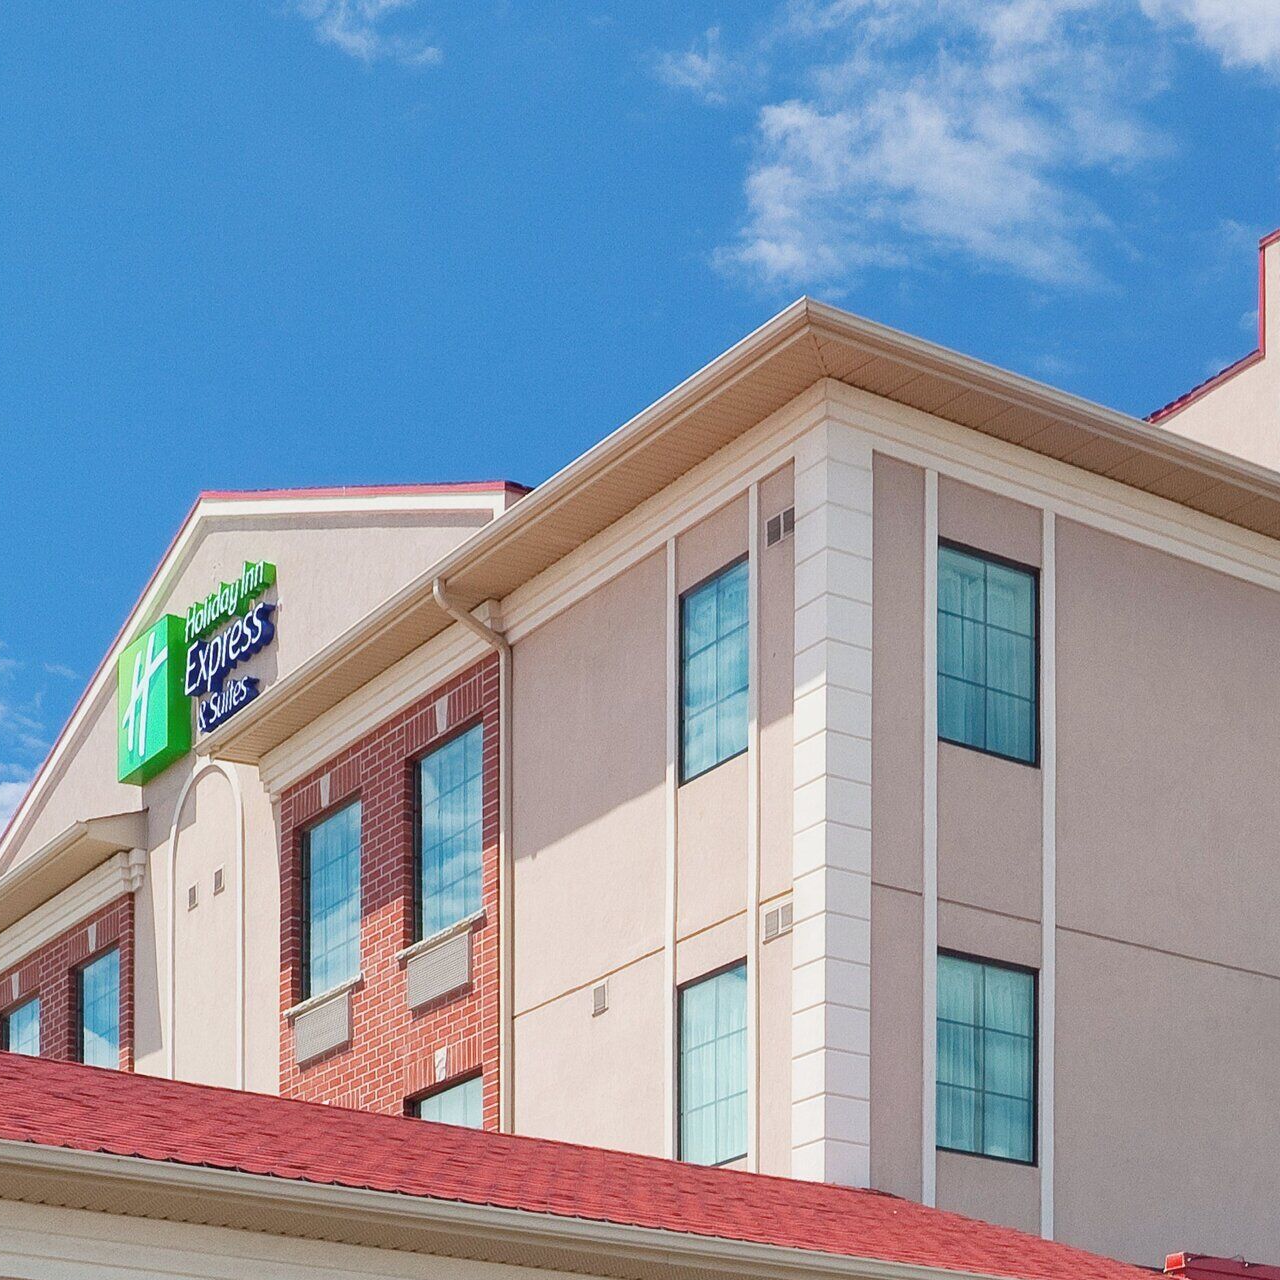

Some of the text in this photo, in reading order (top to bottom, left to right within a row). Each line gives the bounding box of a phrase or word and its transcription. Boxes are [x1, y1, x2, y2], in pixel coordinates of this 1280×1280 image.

[184, 560, 264, 644] Holiday Inn
[184, 601, 264, 697] Express
[197, 675, 249, 733] & Suites
